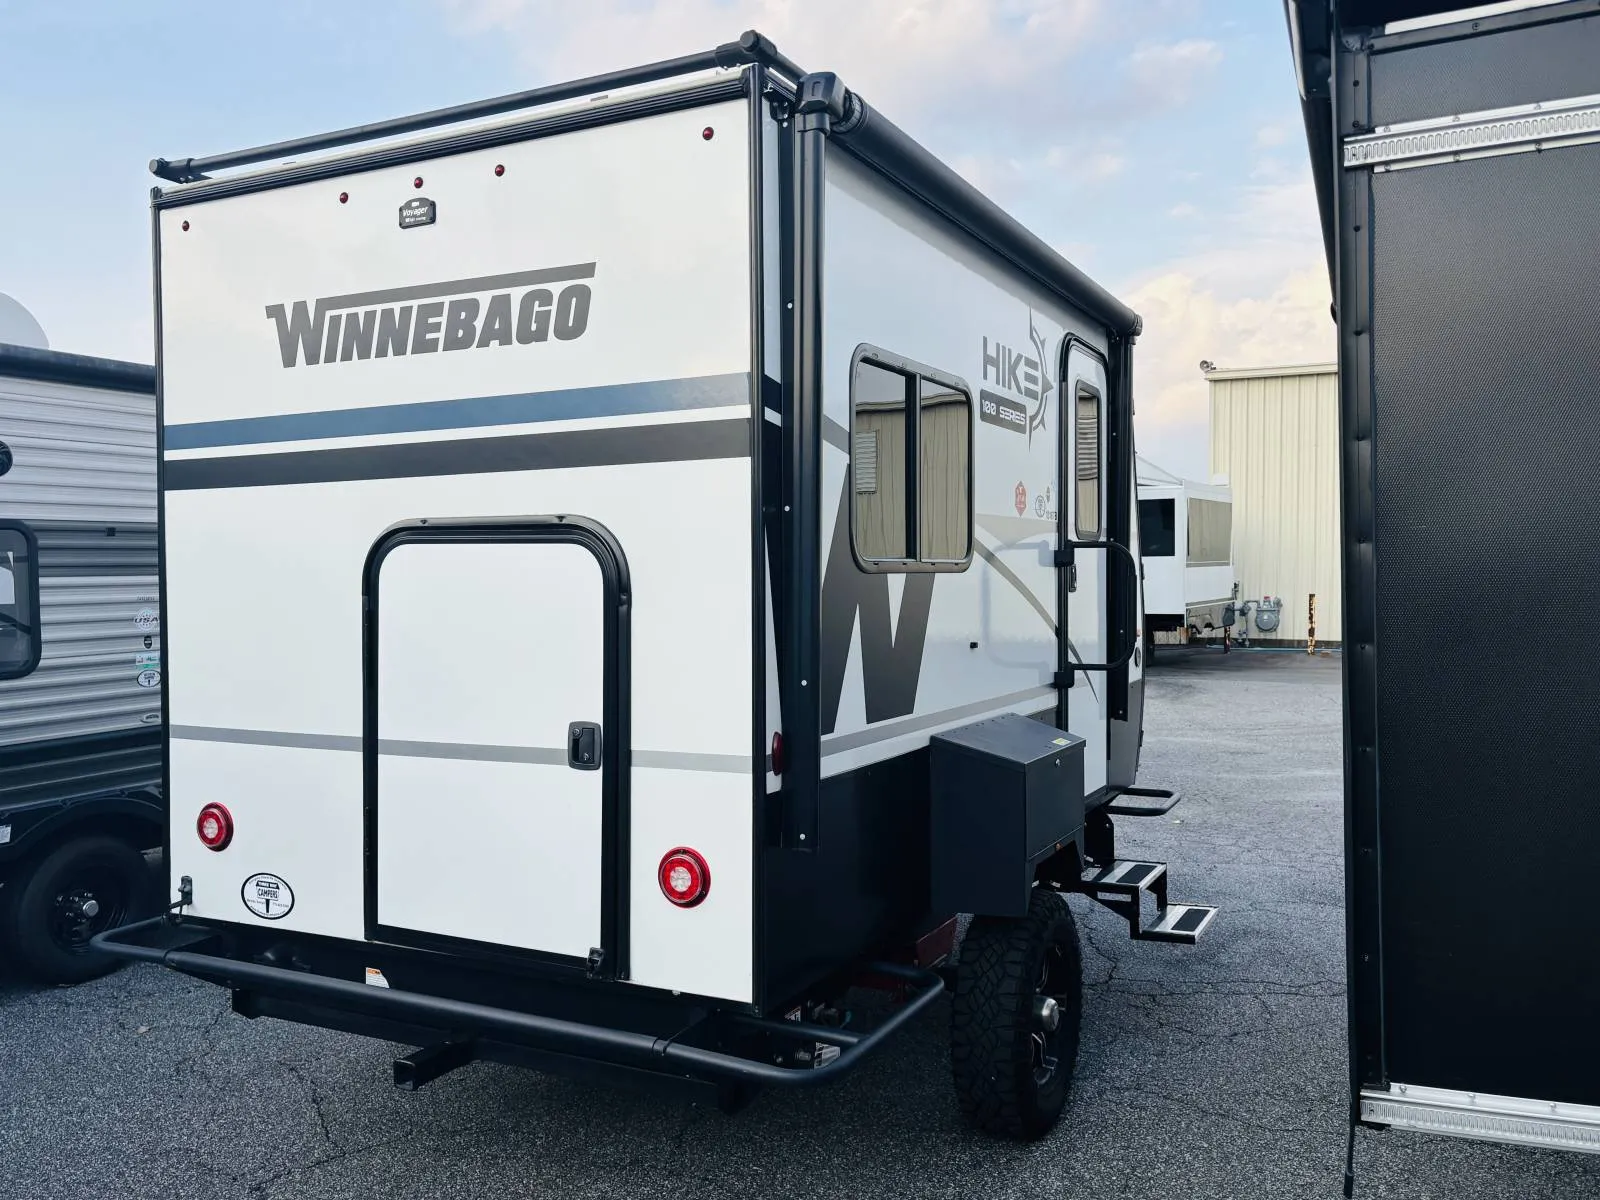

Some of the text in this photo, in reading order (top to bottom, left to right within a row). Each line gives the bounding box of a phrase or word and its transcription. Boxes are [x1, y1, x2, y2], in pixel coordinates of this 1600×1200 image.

[402, 206, 428, 217] Voyager
[265, 262, 597, 369] WINNEBAGO
[982, 335, 1039, 401] HIKE
[982, 399, 1026, 425] 100 SERIES
[257, 888, 278, 898] CAMPERS
